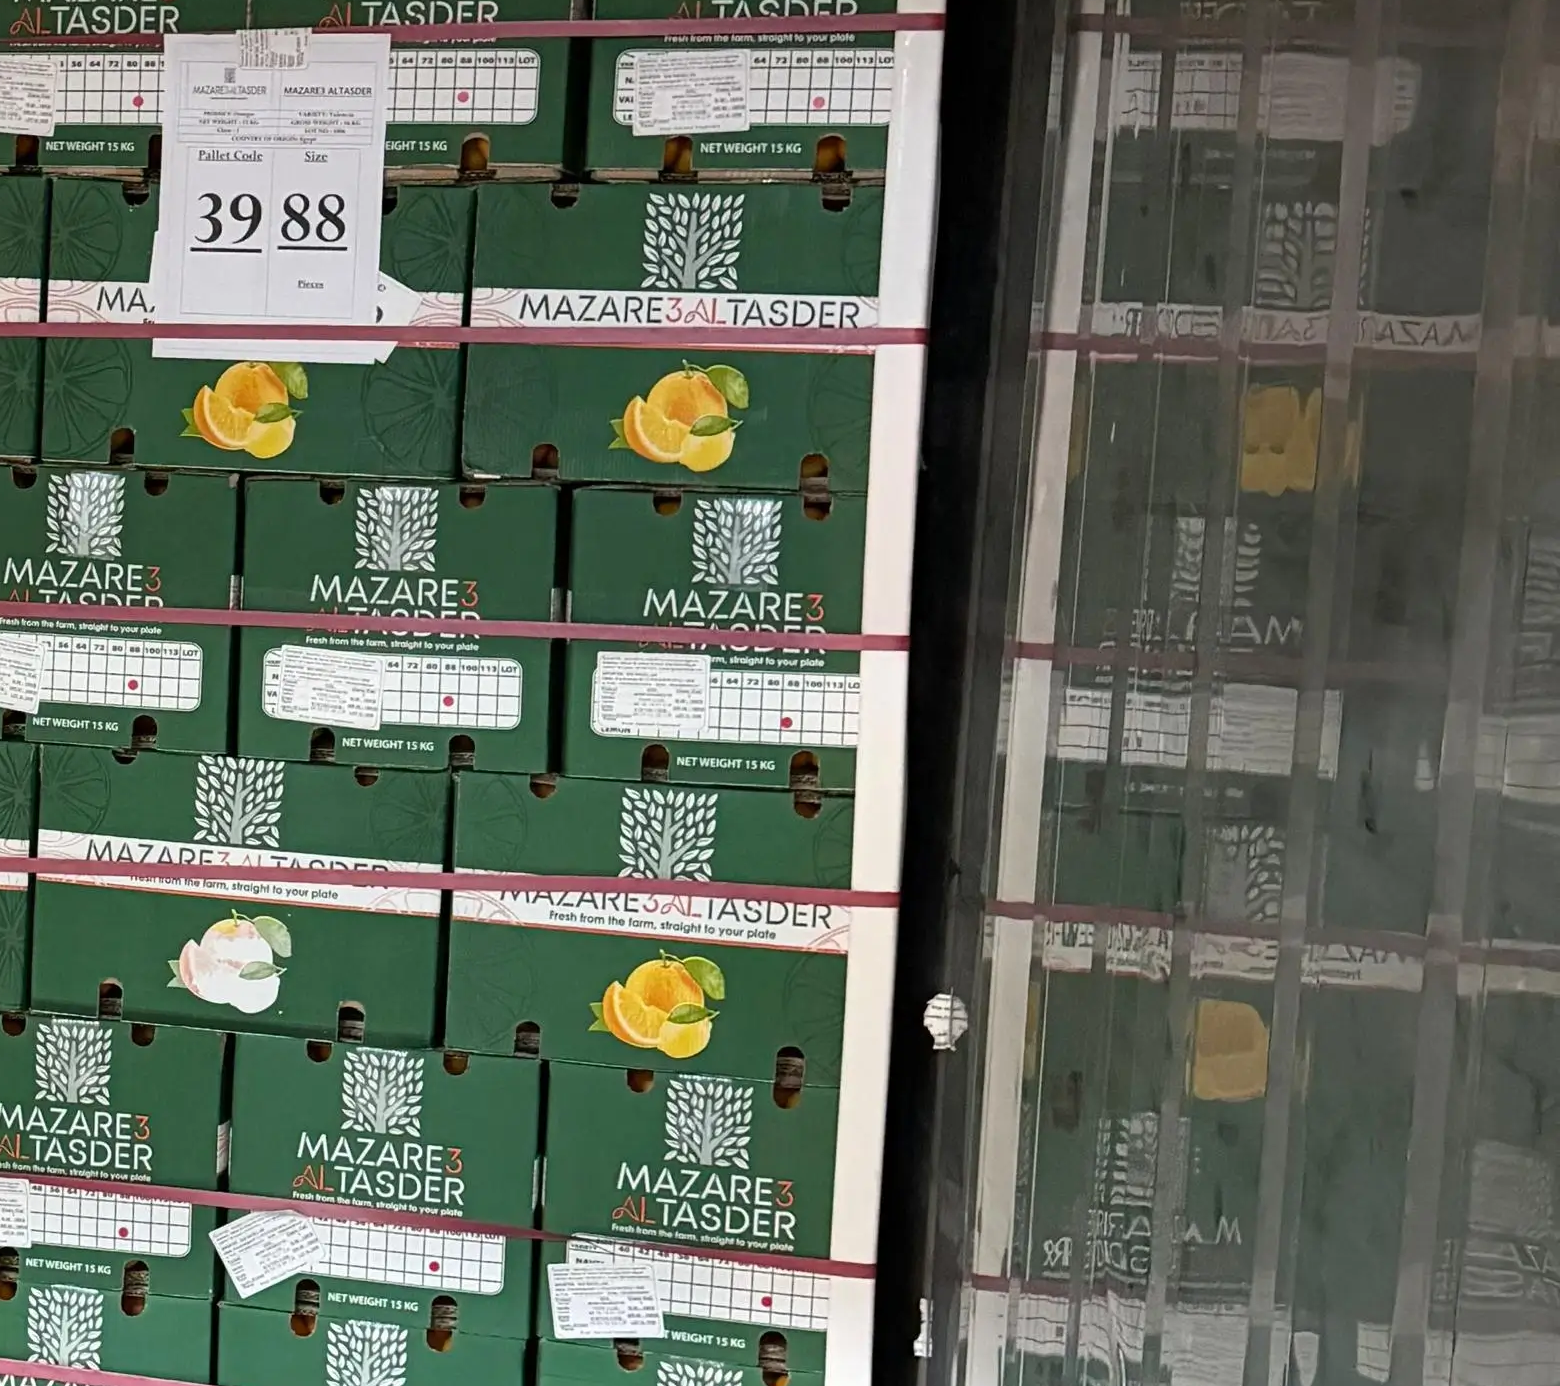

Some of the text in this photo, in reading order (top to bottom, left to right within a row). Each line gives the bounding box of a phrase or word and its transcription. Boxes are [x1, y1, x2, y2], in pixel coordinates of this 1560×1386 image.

[9, 6, 180, 34] ALTASDER
[198, 150, 263, 161] Pallet Code
[305, 151, 328, 161] Size
[700, 143, 801, 154] NET WEIGHT 15 KG
[194, 192, 262, 244] 39
[281, 193, 347, 242] 88
[298, 280, 324, 289] Pieces
[519, 293, 861, 328] MAZARE3ALTASDER
[3, 558, 162, 592] MAZARE3
[310, 574, 478, 608] MAZARE3
[643, 588, 824, 621] MAZARE3
[677, 757, 776, 770] NET WEIGHT 15 KG
[297, 1131, 463, 1174] MAZARE3
[292, 1165, 464, 1206] ALTASDER
[617, 1162, 794, 1208] MAZARE3
[612, 1195, 795, 1240] ALTASDER
[26, 1258, 111, 1275] NET WEIGHT 15 KG
[328, 1292, 418, 1311] NET WEIGHT 15 KG
